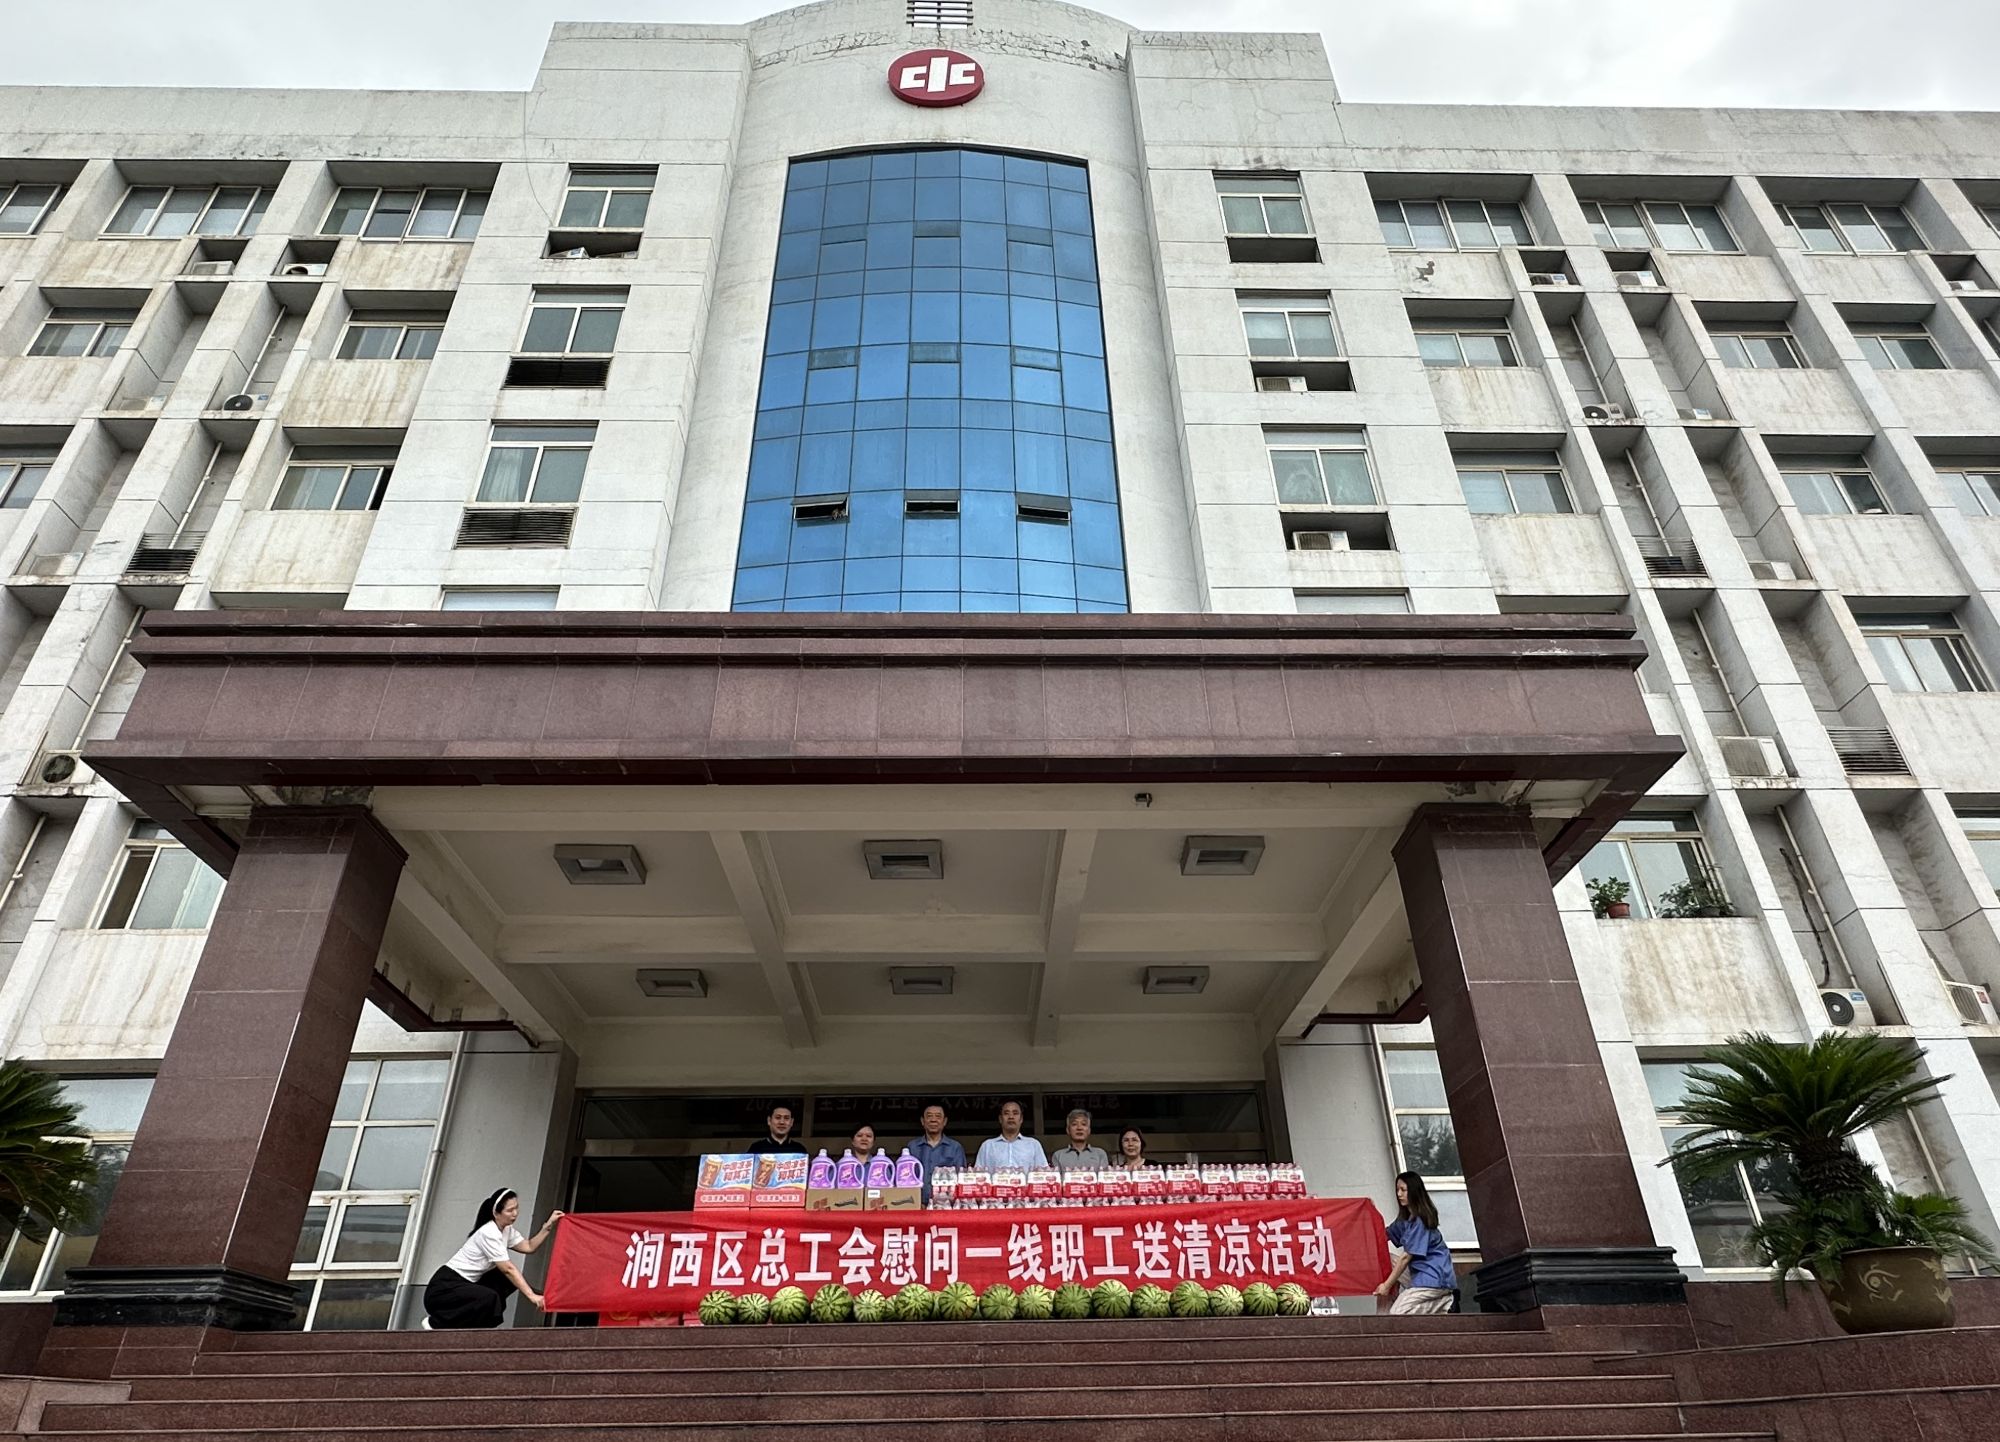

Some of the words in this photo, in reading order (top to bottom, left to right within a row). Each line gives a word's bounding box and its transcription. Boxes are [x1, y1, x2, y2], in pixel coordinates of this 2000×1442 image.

[621, 1216, 1337, 1289] 涧西区总工会慰问一线职工送清凉活动
